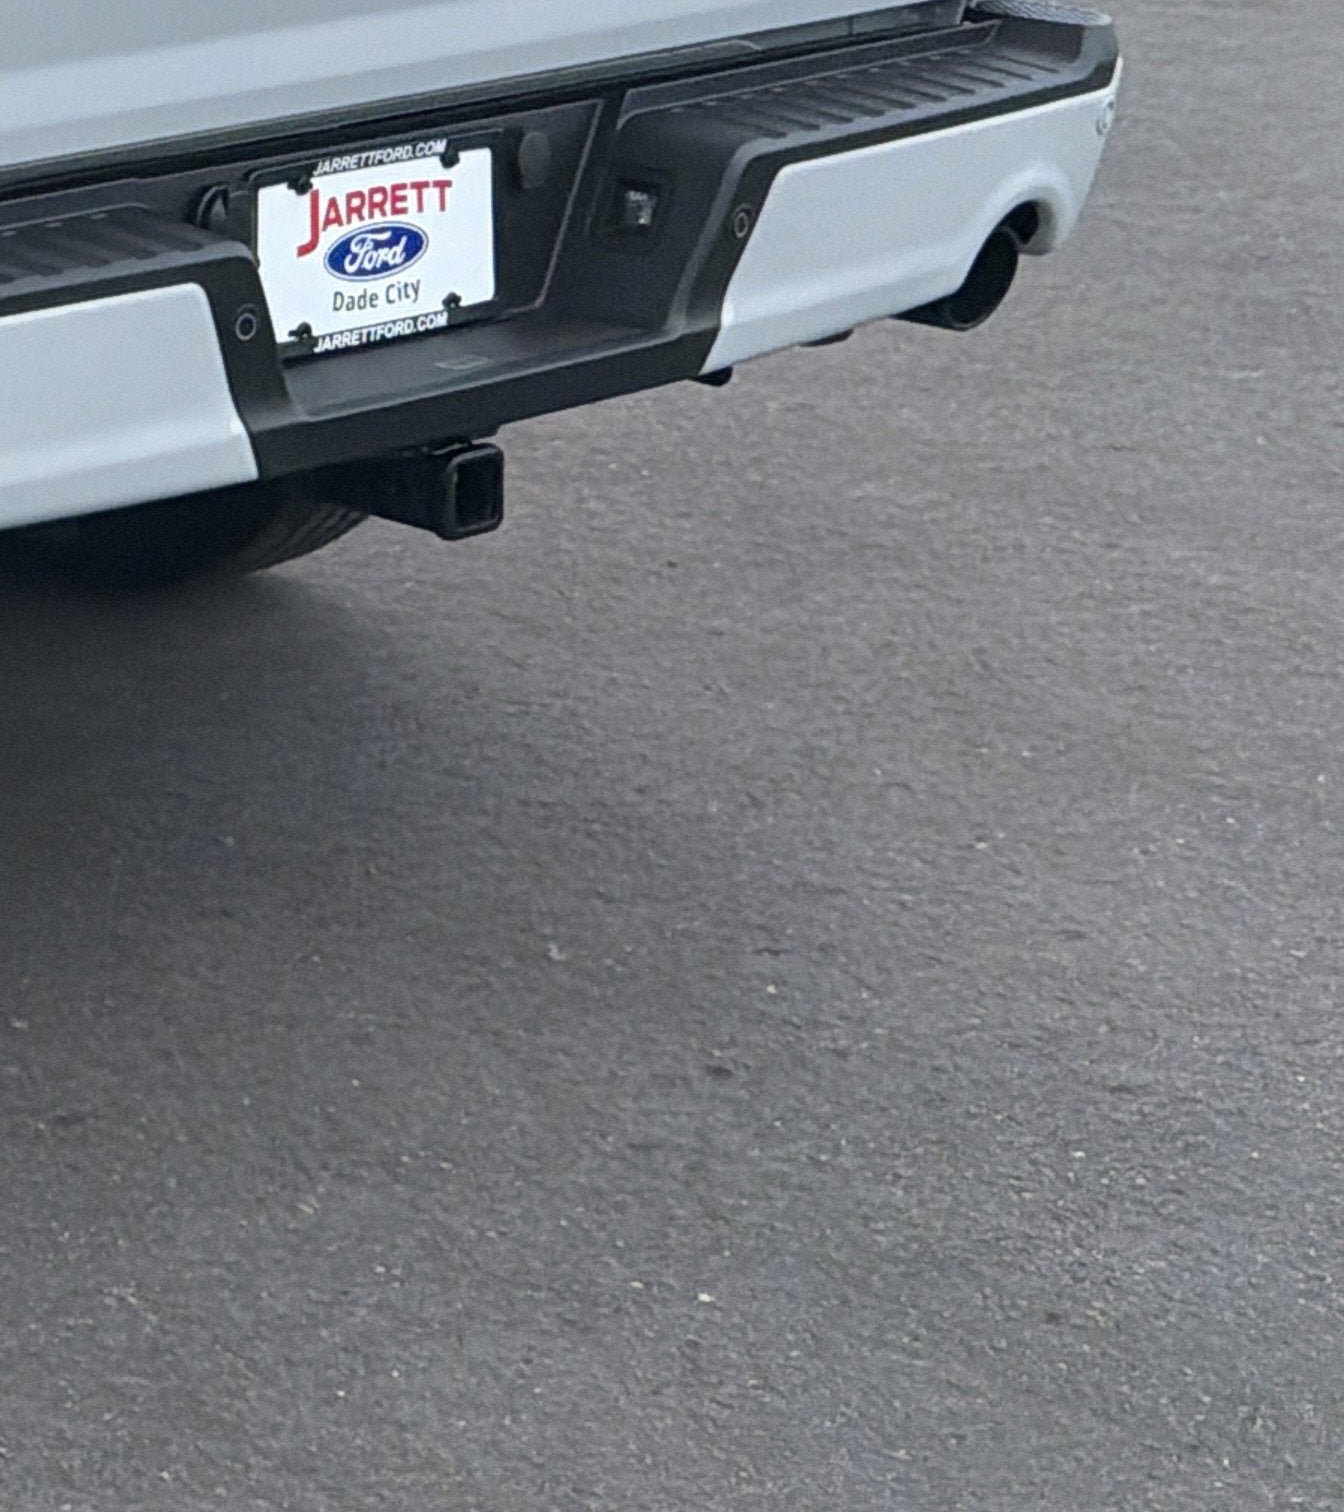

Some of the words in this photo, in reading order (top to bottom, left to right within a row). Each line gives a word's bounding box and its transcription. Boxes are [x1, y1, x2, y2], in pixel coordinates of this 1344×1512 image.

[313, 139, 448, 176] JARRETTFORD.COM
[296, 180, 453, 257] JARRETT
[344, 231, 408, 273] Ford
[332, 290, 379, 312] Dade
[385, 279, 421, 306] City
[313, 311, 449, 353] JARRETTFORD.COM
